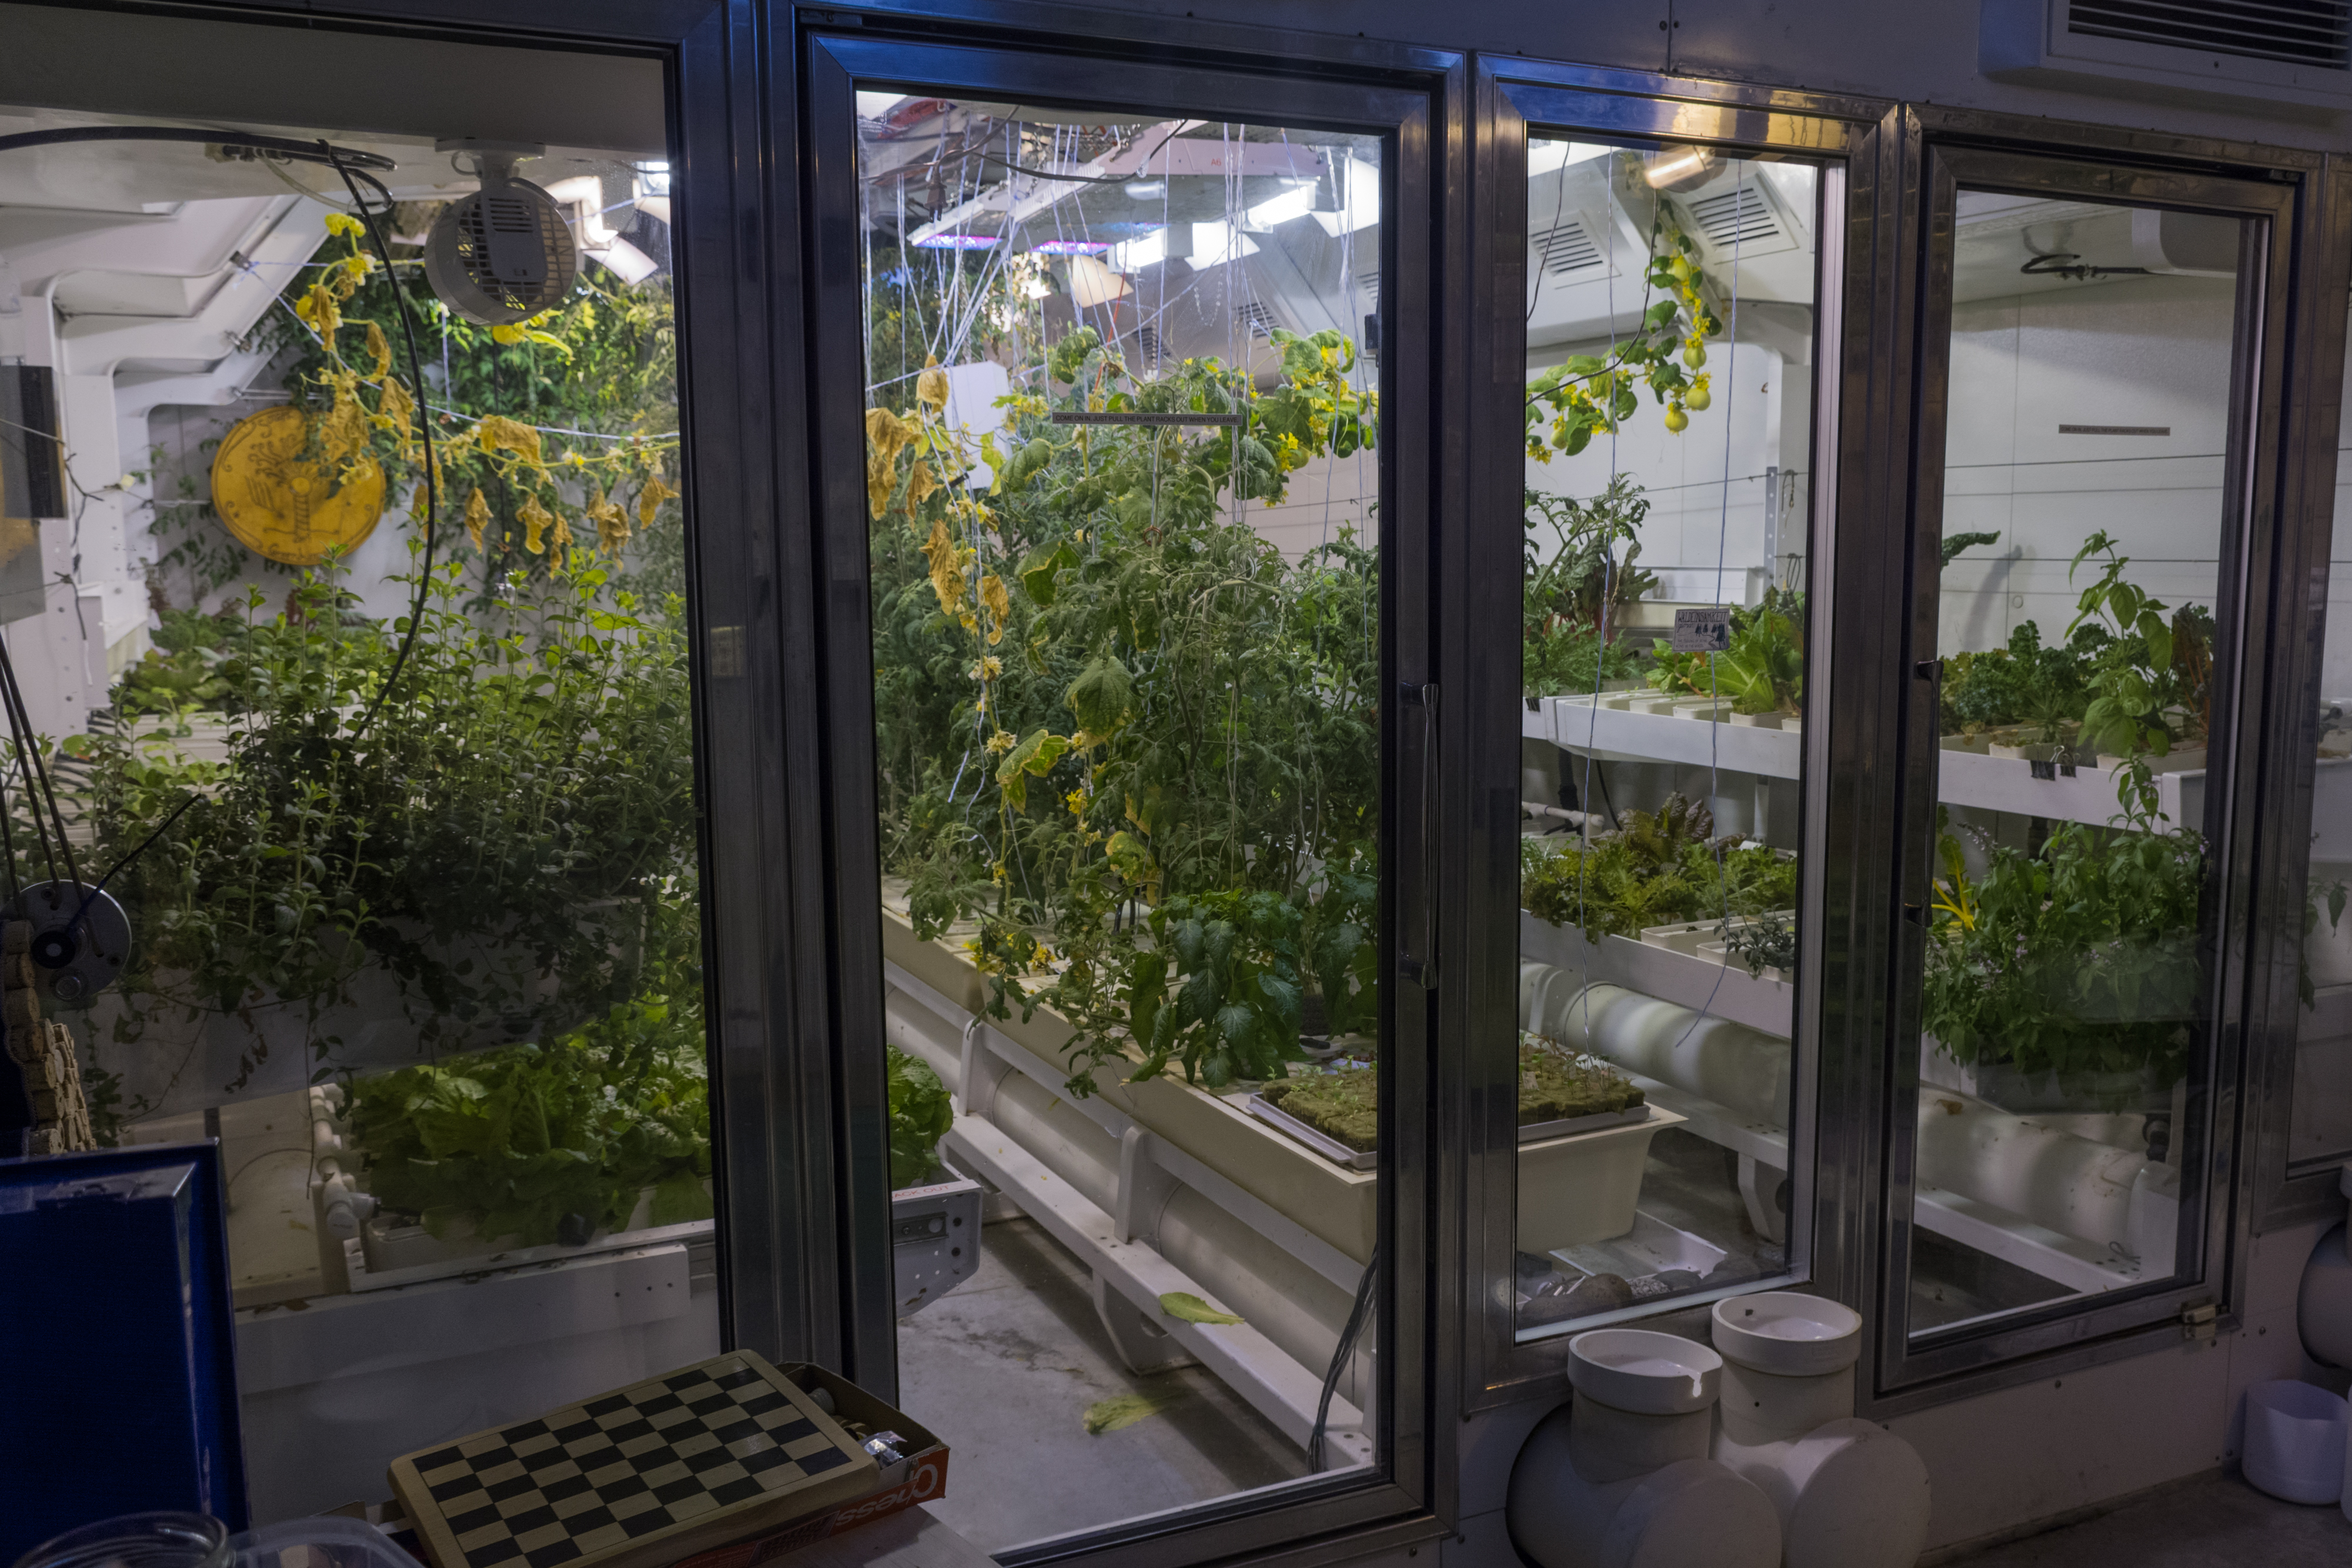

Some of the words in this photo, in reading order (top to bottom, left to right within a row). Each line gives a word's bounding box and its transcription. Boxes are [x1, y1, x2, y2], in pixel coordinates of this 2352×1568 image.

[1211, 158, 1222, 166] A6
[1678, 611, 1728, 623] WALDEINSAMKEIT
[891, 1189, 920, 1198] ACK
[835, 1463, 938, 1527] Chess
